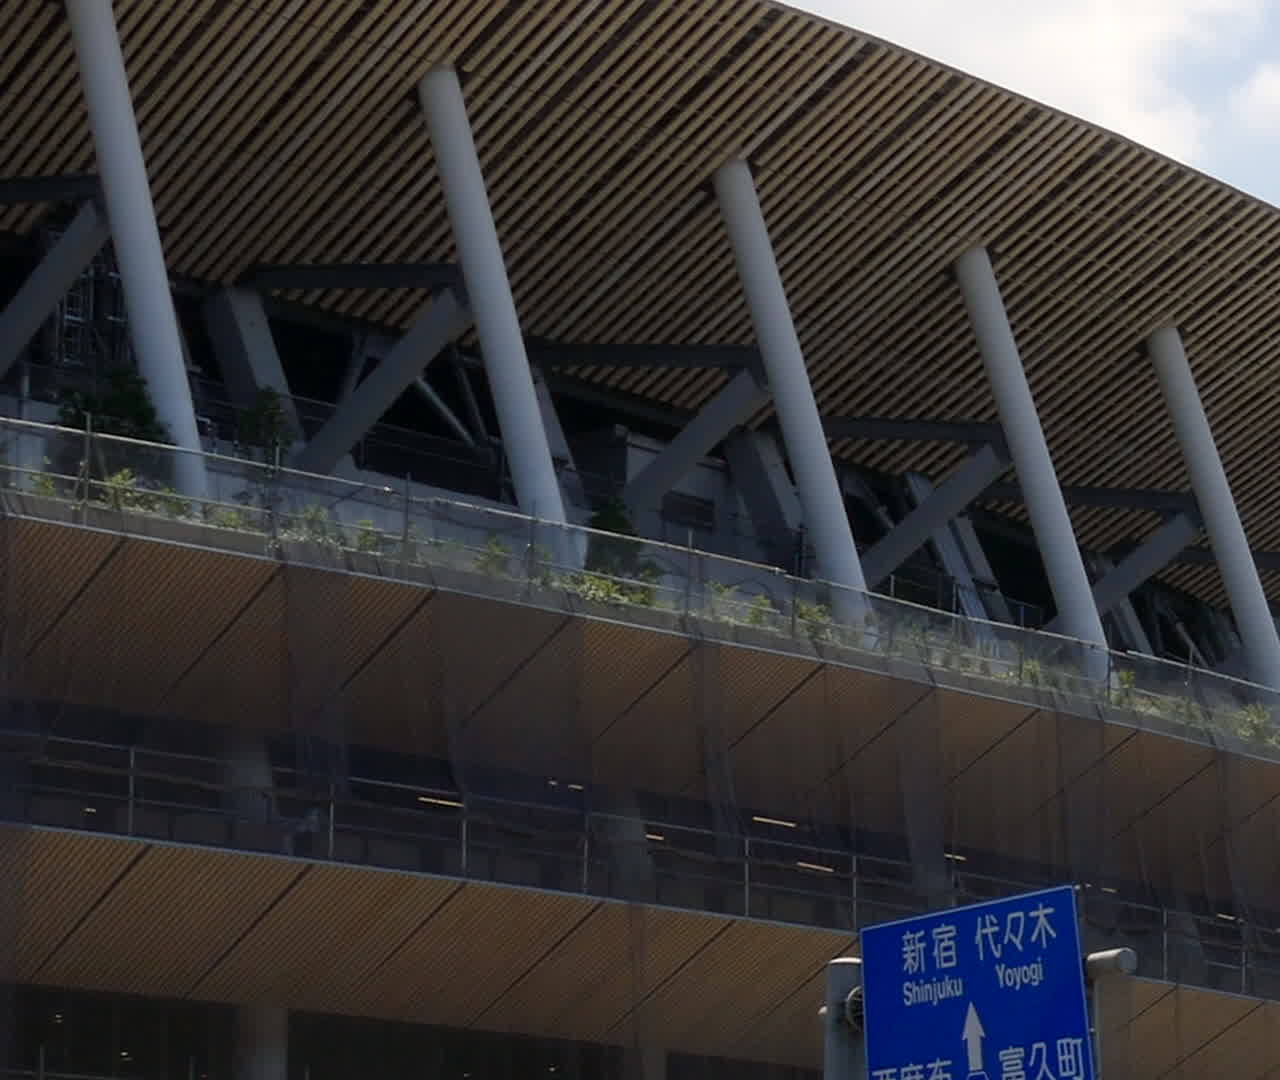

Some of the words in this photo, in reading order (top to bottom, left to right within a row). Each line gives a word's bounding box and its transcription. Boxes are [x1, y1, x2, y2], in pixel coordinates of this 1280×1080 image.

[902, 923, 957, 975] 新宿
[975, 903, 1056, 961] 代々木
[903, 975, 963, 1006] Shinjuku
[995, 956, 1043, 991] Yoyogi
